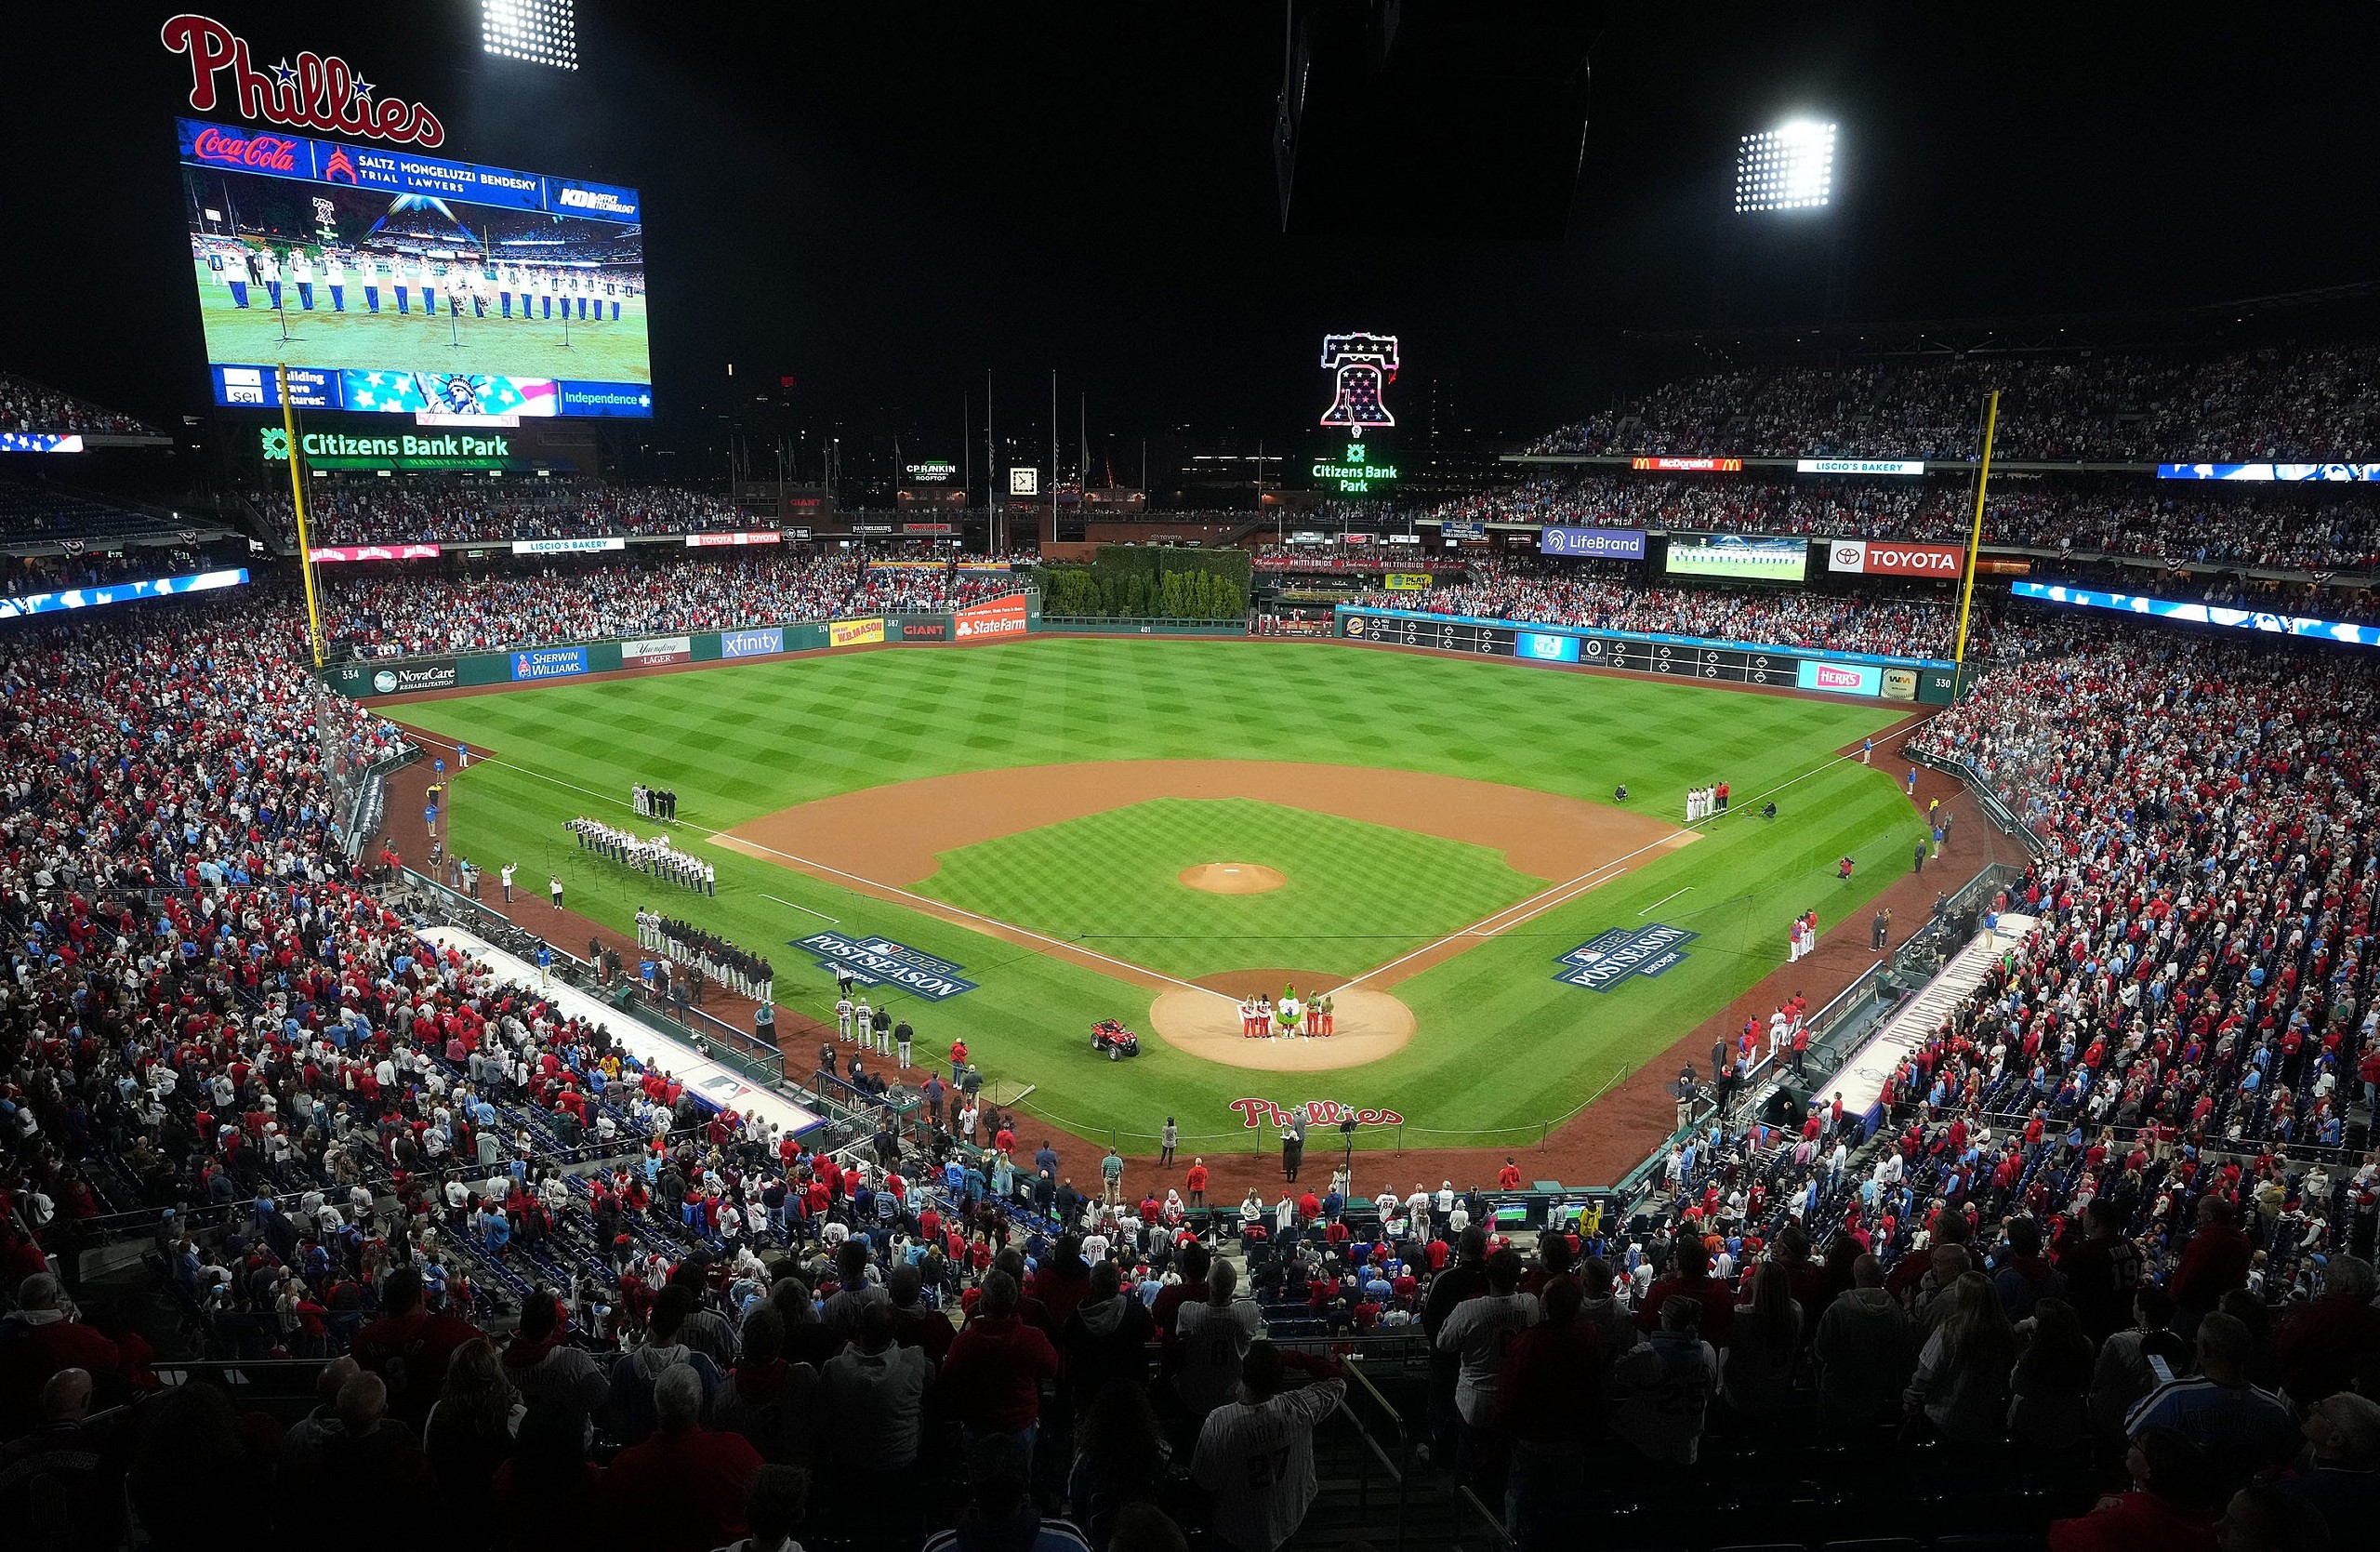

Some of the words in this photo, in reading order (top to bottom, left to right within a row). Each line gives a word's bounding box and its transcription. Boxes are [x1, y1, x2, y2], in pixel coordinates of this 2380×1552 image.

[161, 14, 444, 148] Phillies
[195, 128, 295, 171] Coca-Cola
[359, 155, 395, 170] SALTZ
[401, 161, 476, 182] MONGELUZZI
[481, 174, 536, 192] BENDESKY
[360, 169, 398, 183] TRIAL
[407, 178, 464, 192] LAWYERS
[597, 193, 618, 204] OFFICE
[595, 202, 636, 215] TECHNOLOGY
[565, 391, 638, 406] Independence
[303, 434, 399, 455] Citizens
[403, 434, 458, 455] Bank
[462, 435, 509, 456] Park
[1659, 458, 1714, 469] McDonald's
[1817, 462, 1858, 471] LISCIO'S
[1861, 463, 1903, 471] BAKERY
[1313, 466, 1363, 478] Citizens
[1365, 466, 1397, 478] Bank
[1340, 480, 1368, 492] Park
[790, 498, 821, 507] GIANT
[530, 541, 568, 551] LISCIO'S
[572, 538, 608, 550] BAKERY
[701, 535, 733, 545] TOYOTA
[748, 533, 778, 543] TOYOTA
[1570, 536, 1639, 551] LifeBrand
[1870, 550, 1956, 570] TOYOTA
[904, 626, 945, 635] GIANT
[726, 632, 779, 656] xfinity
[532, 652, 578, 665] SHERWIN
[643, 655, 670, 665] LAGER
[342, 670, 360, 680] 334
[1820, 670, 1857, 686] HERR'S
[400, 680, 454, 690] REHABILITATION
[1936, 678, 1951, 689] 330
[1592, 931, 1633, 952] 2023
[890, 950, 951, 974] 2023
[1570, 926, 1685, 988] POSTSEASON
[803, 935, 962, 997] POSTSEASON
[1230, 1098, 1405, 1128] Phllies
[1247, 1422, 1285, 1444] NOLA
